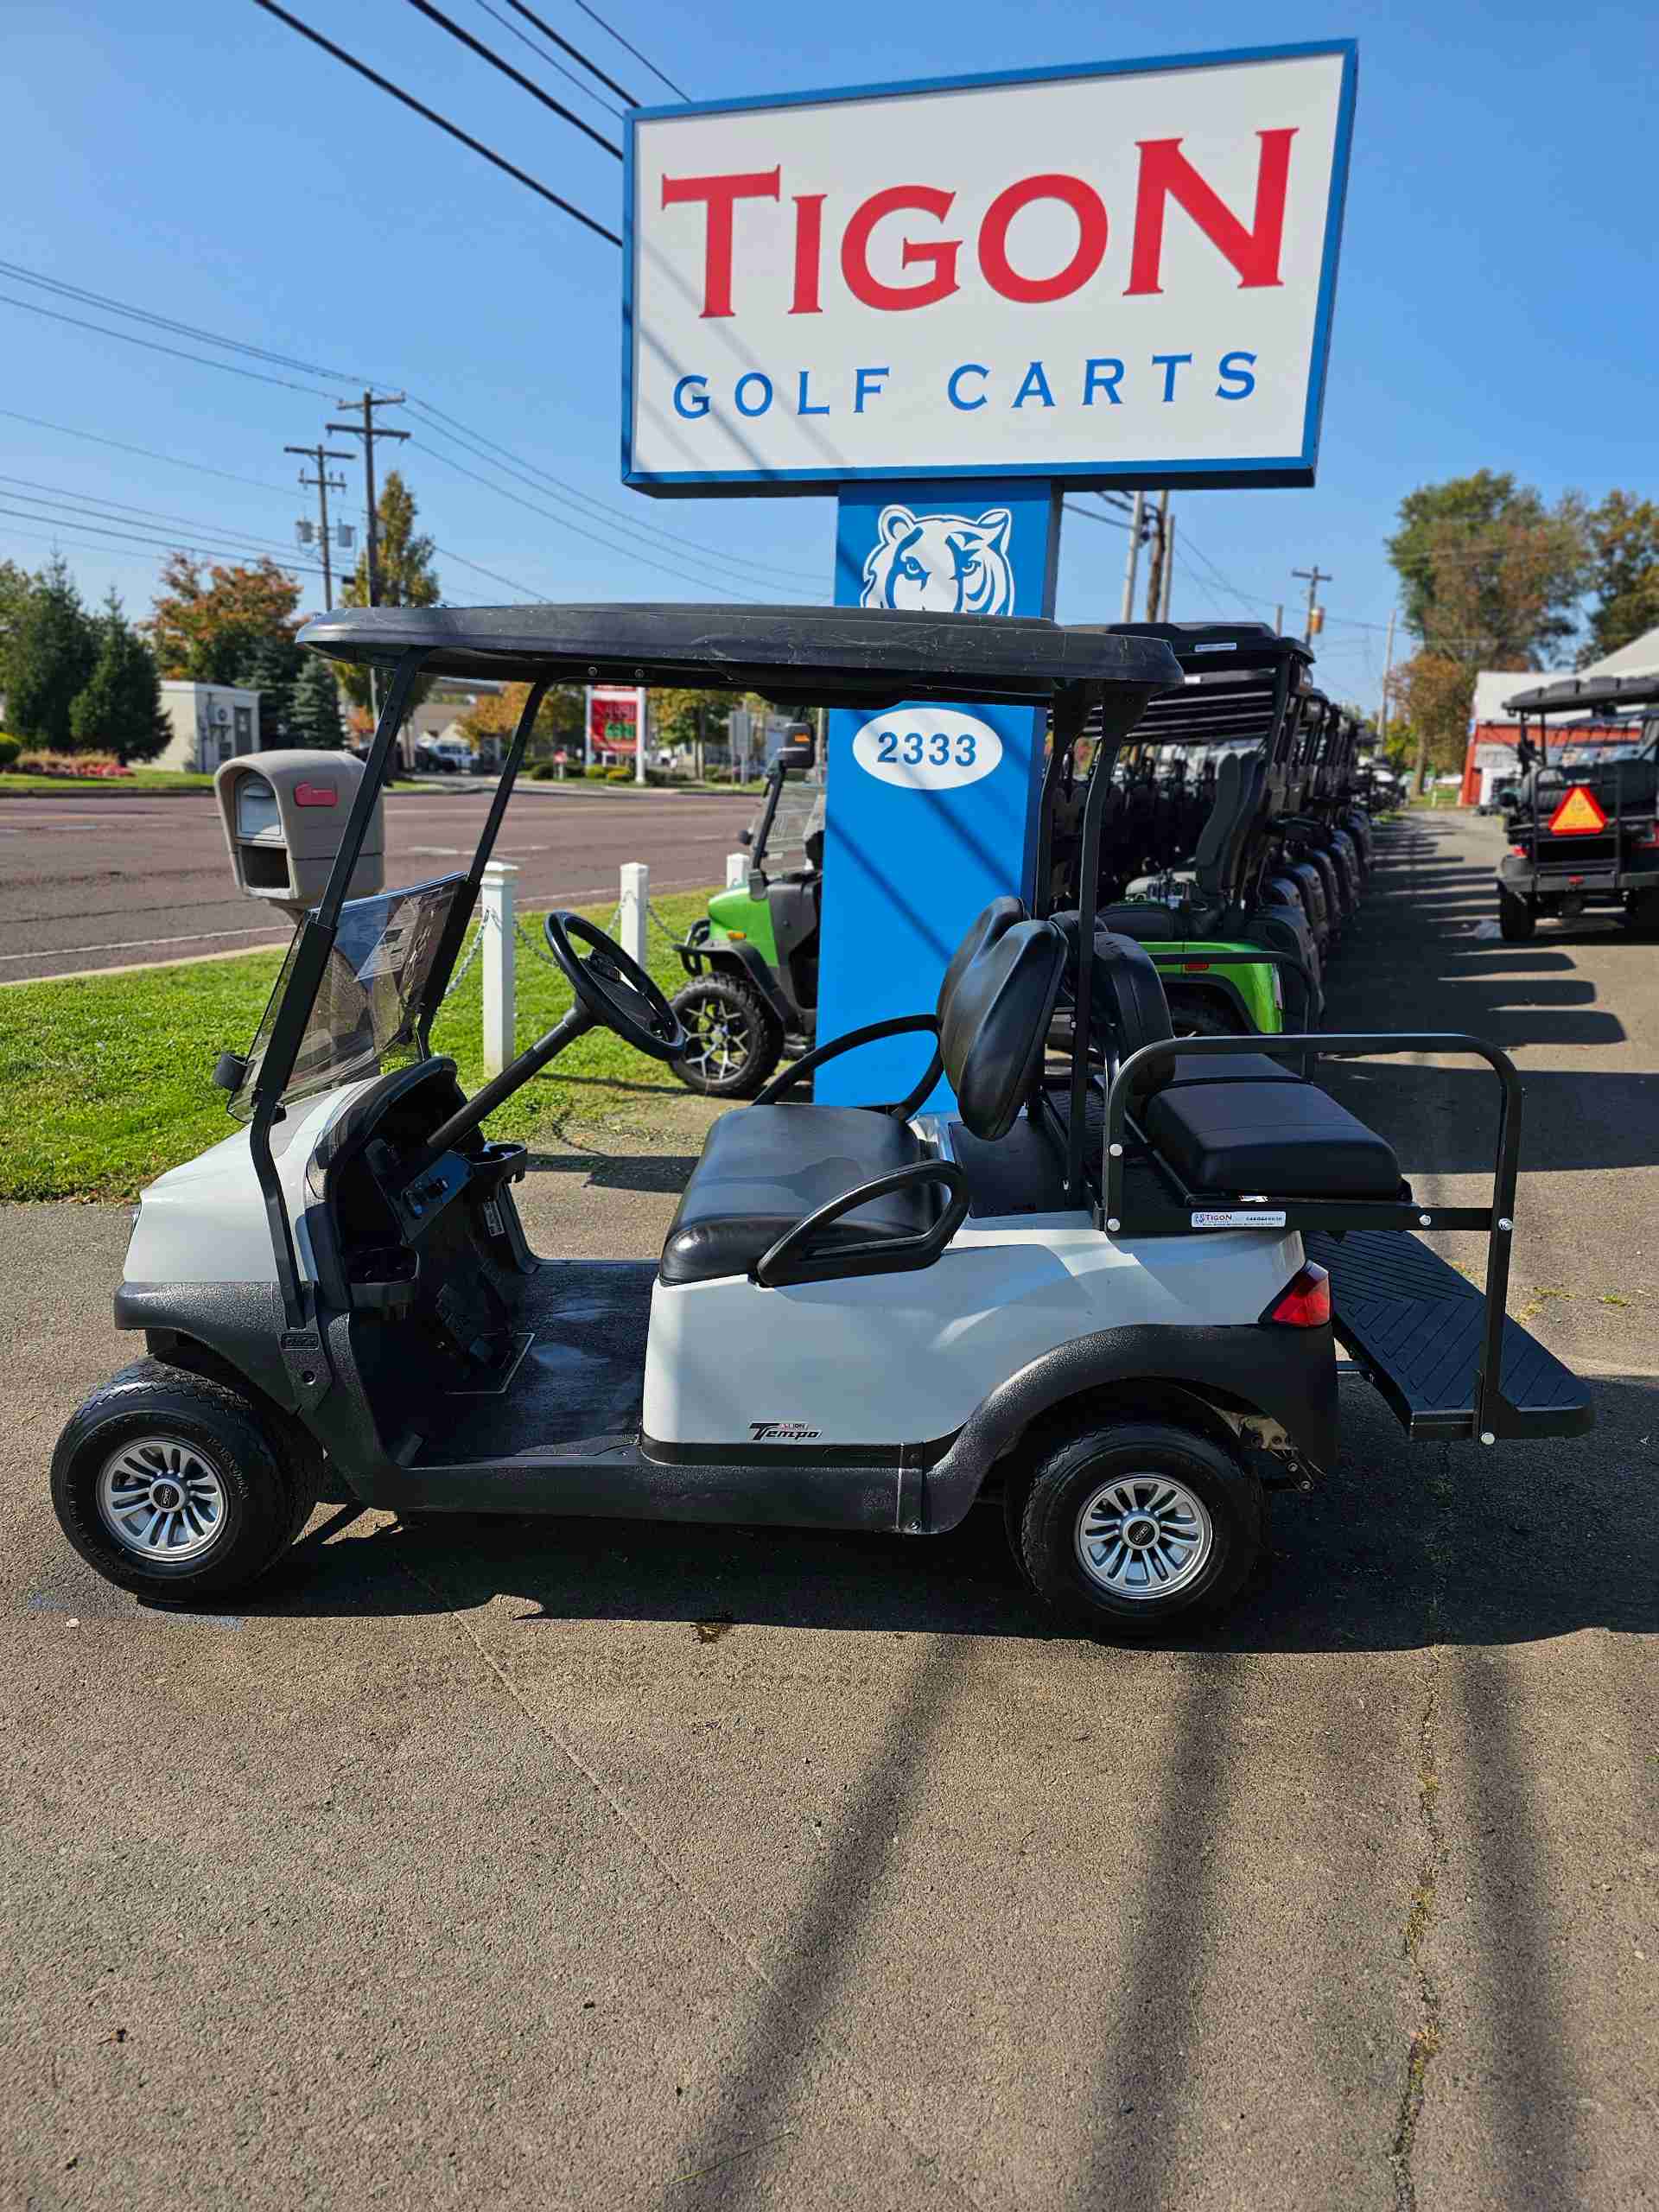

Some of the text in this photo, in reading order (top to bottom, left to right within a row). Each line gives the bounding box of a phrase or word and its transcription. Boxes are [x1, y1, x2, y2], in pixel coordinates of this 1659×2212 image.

[663, 128, 1299, 318] TIGON
[673, 352, 1257, 420] GOLF CARTS
[878, 732, 976, 767] 2333
[749, 1422, 821, 1440] Tempo
